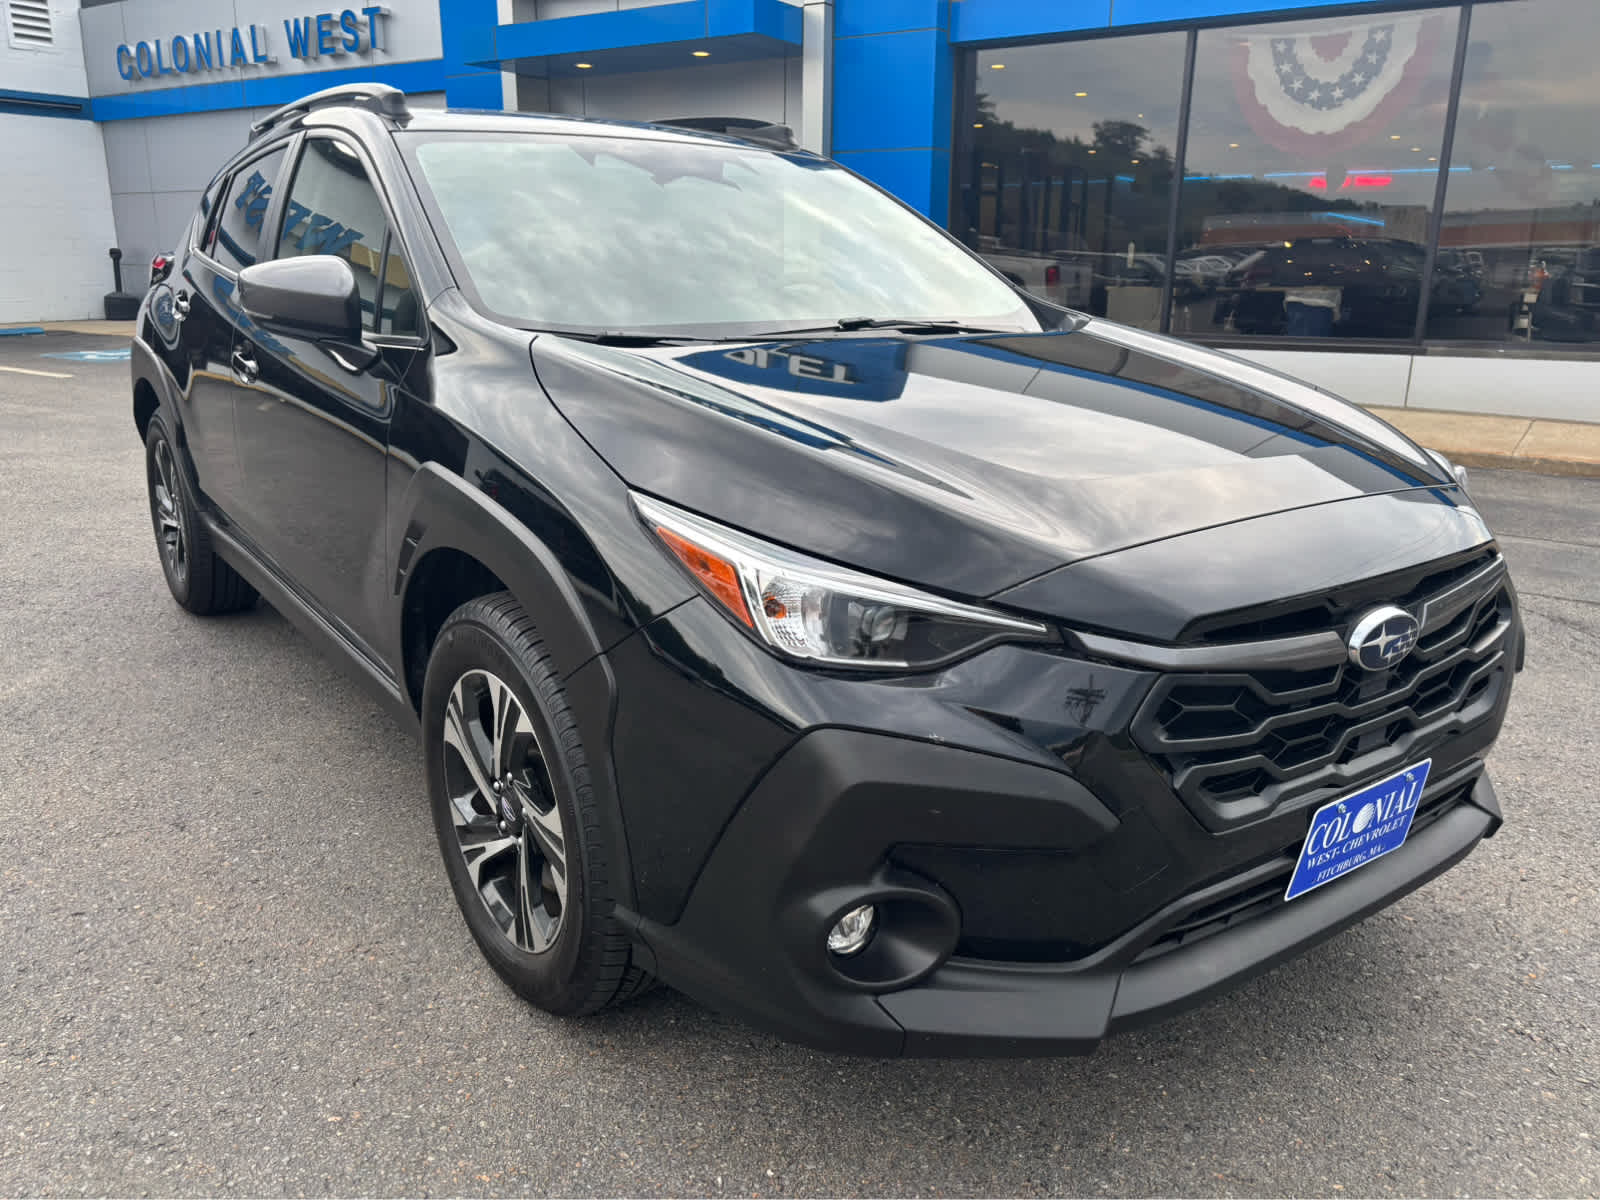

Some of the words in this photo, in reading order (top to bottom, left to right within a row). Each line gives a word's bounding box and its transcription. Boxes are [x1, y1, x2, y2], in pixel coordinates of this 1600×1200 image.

[116, 25, 269, 81] COLONIAL
[284, 6, 382, 59] WEST
[1307, 780, 1419, 856] COLONIAL
[1342, 815, 1407, 853] CHEVROLET
